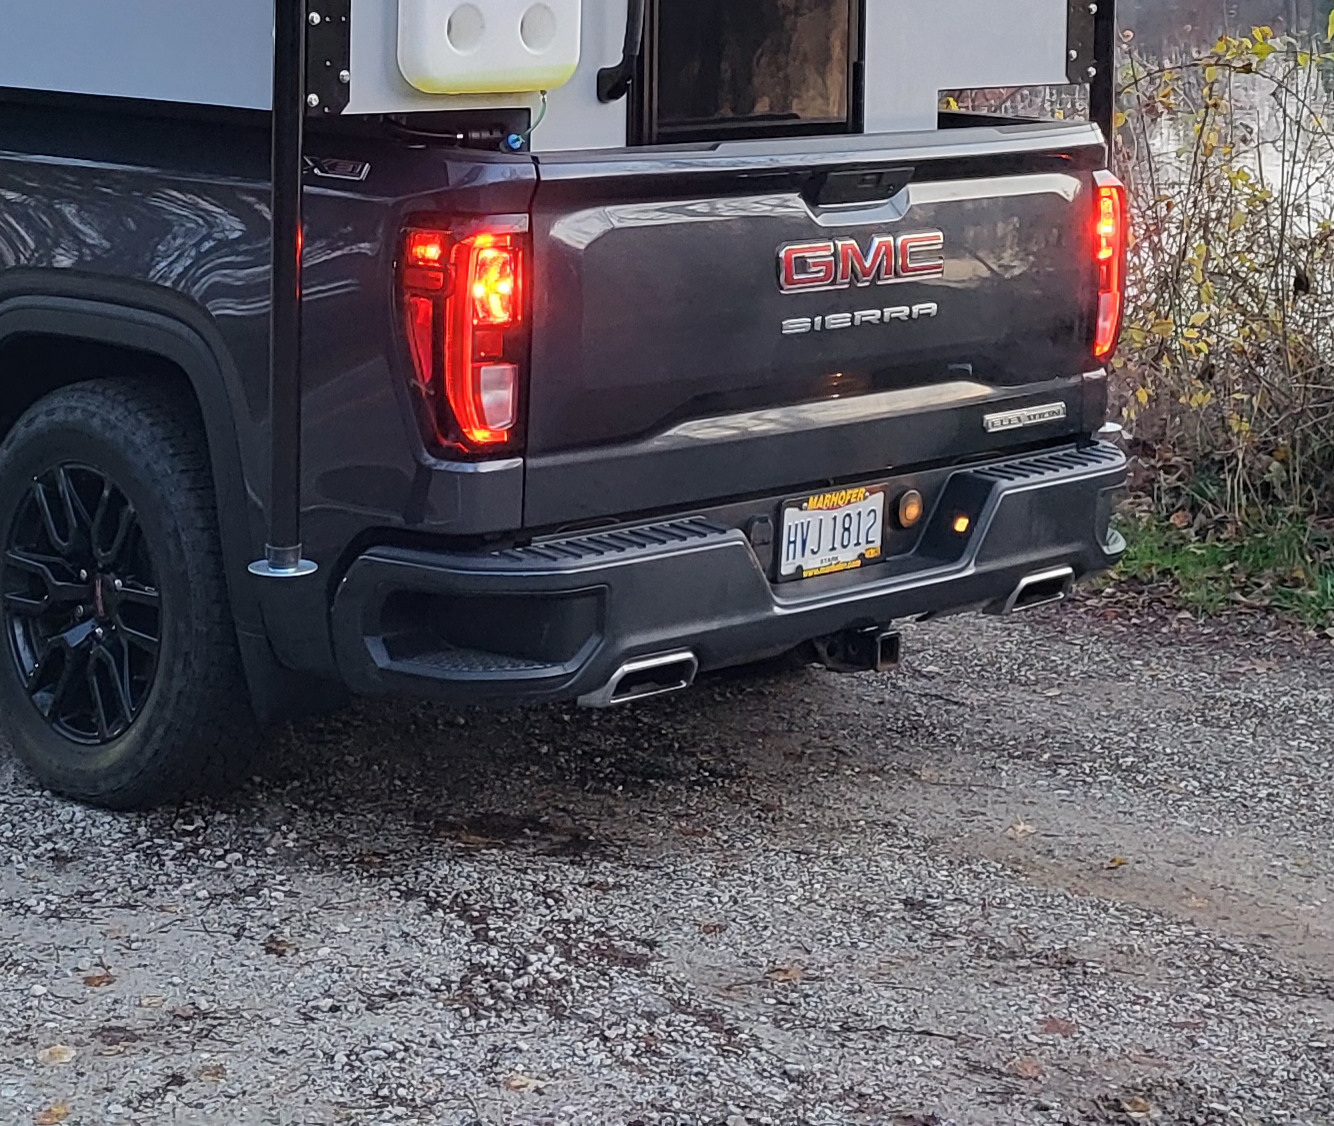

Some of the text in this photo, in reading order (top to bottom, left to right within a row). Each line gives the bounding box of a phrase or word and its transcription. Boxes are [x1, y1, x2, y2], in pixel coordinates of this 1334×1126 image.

[777, 228, 944, 294] GMC
[782, 302, 938, 334] SIERRA
[807, 487, 866, 510] MARHOFER
[786, 508, 877, 562] HVJ 1812
